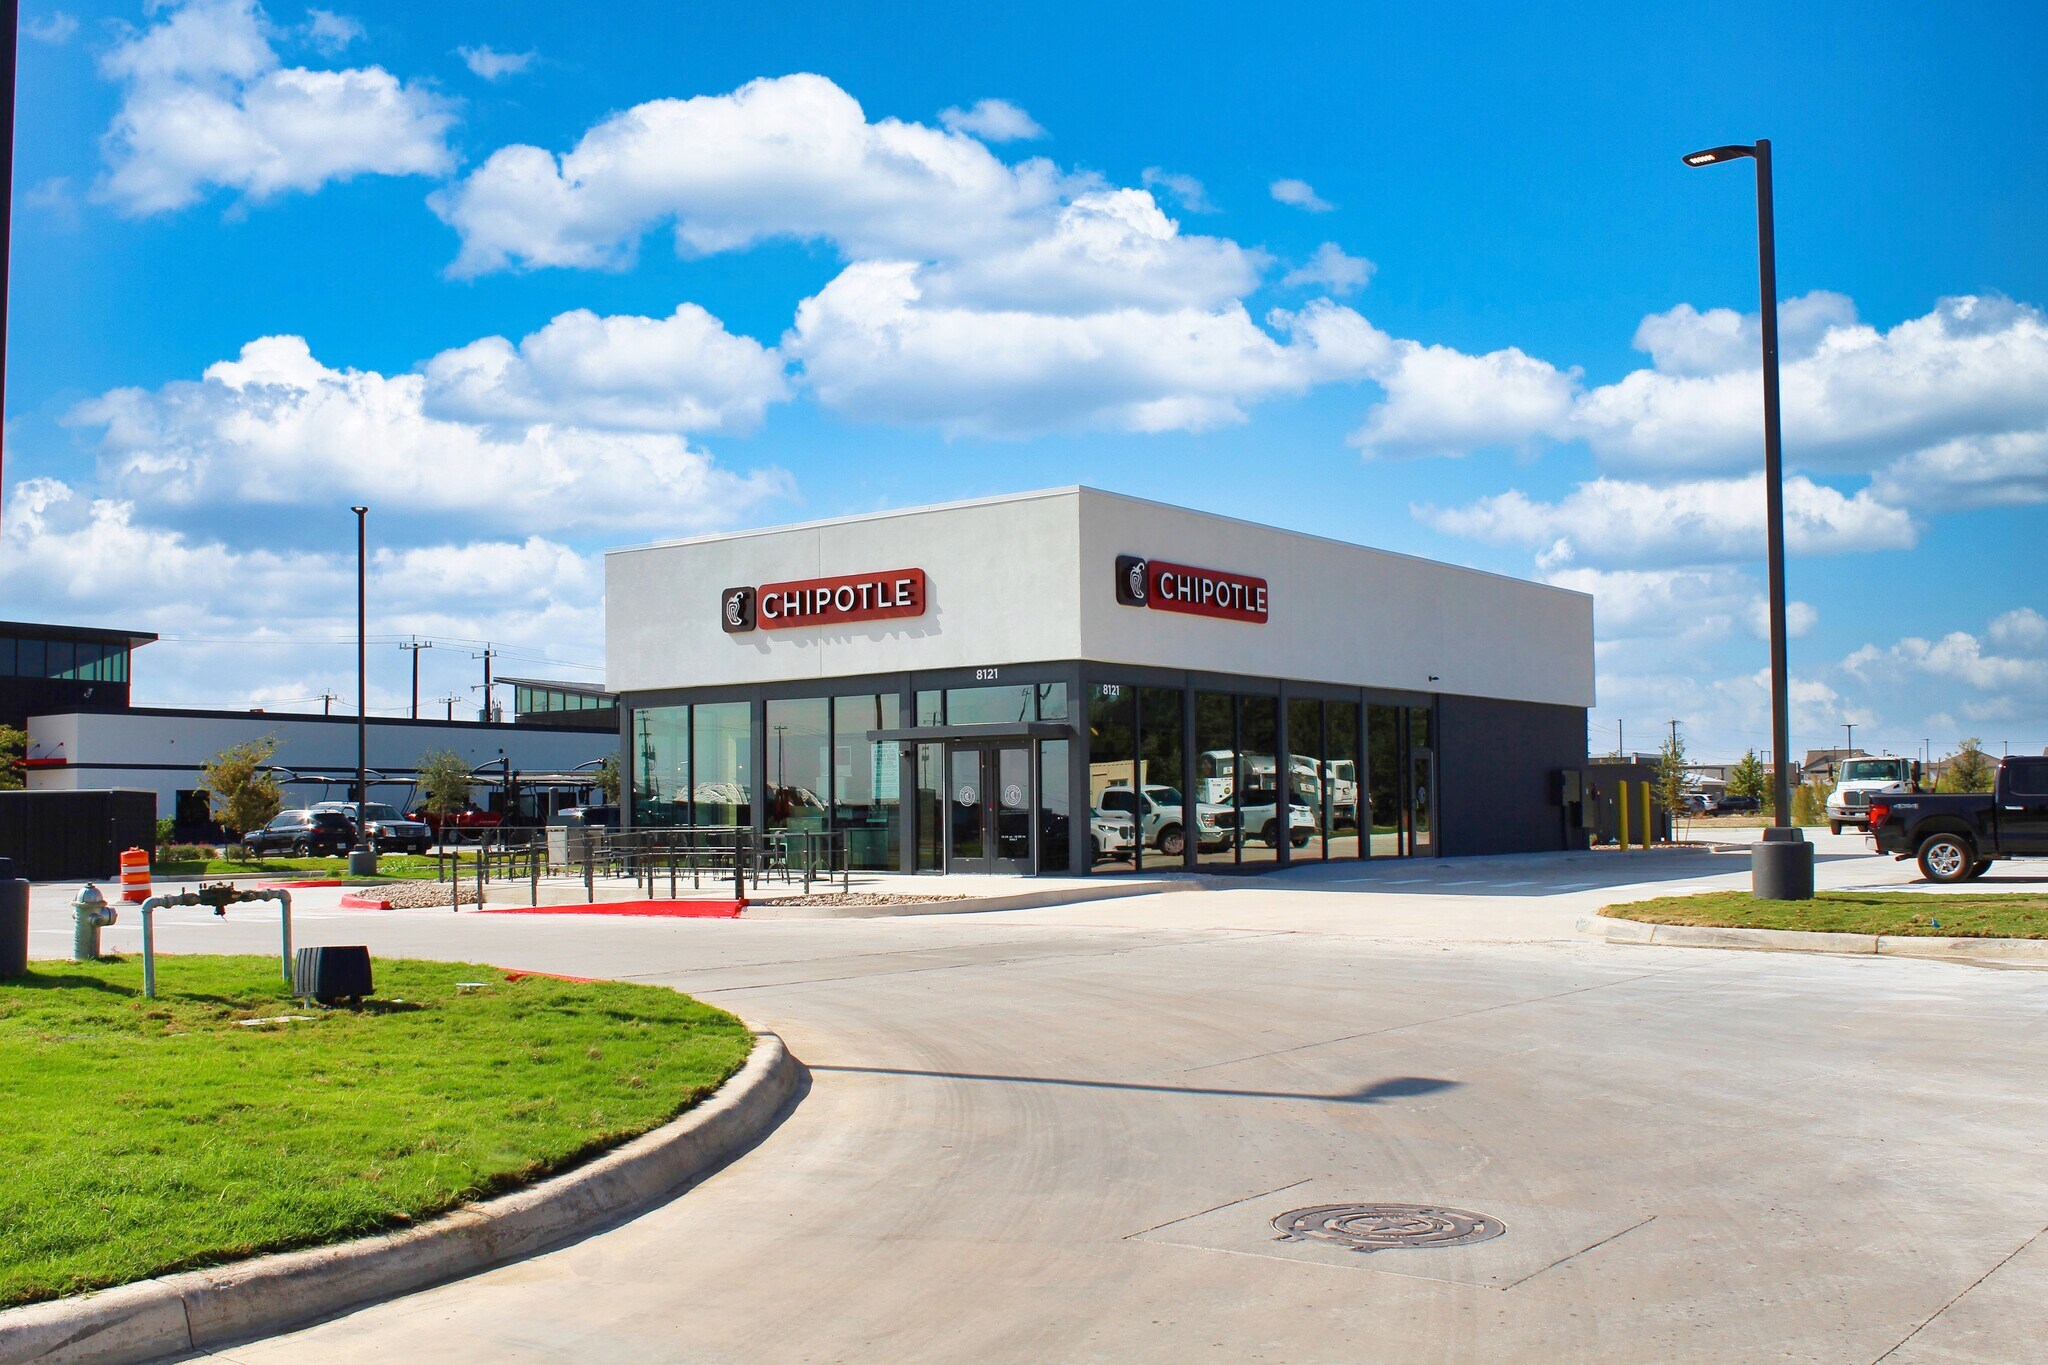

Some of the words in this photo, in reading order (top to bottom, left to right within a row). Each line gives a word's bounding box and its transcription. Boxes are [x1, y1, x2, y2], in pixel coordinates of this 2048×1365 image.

[762, 579, 912, 619] CHIPOTLE
[1160, 572, 1267, 613] CHIPOTLE
[976, 668, 998, 680] 8121
[1102, 684, 1120, 696] 8121
